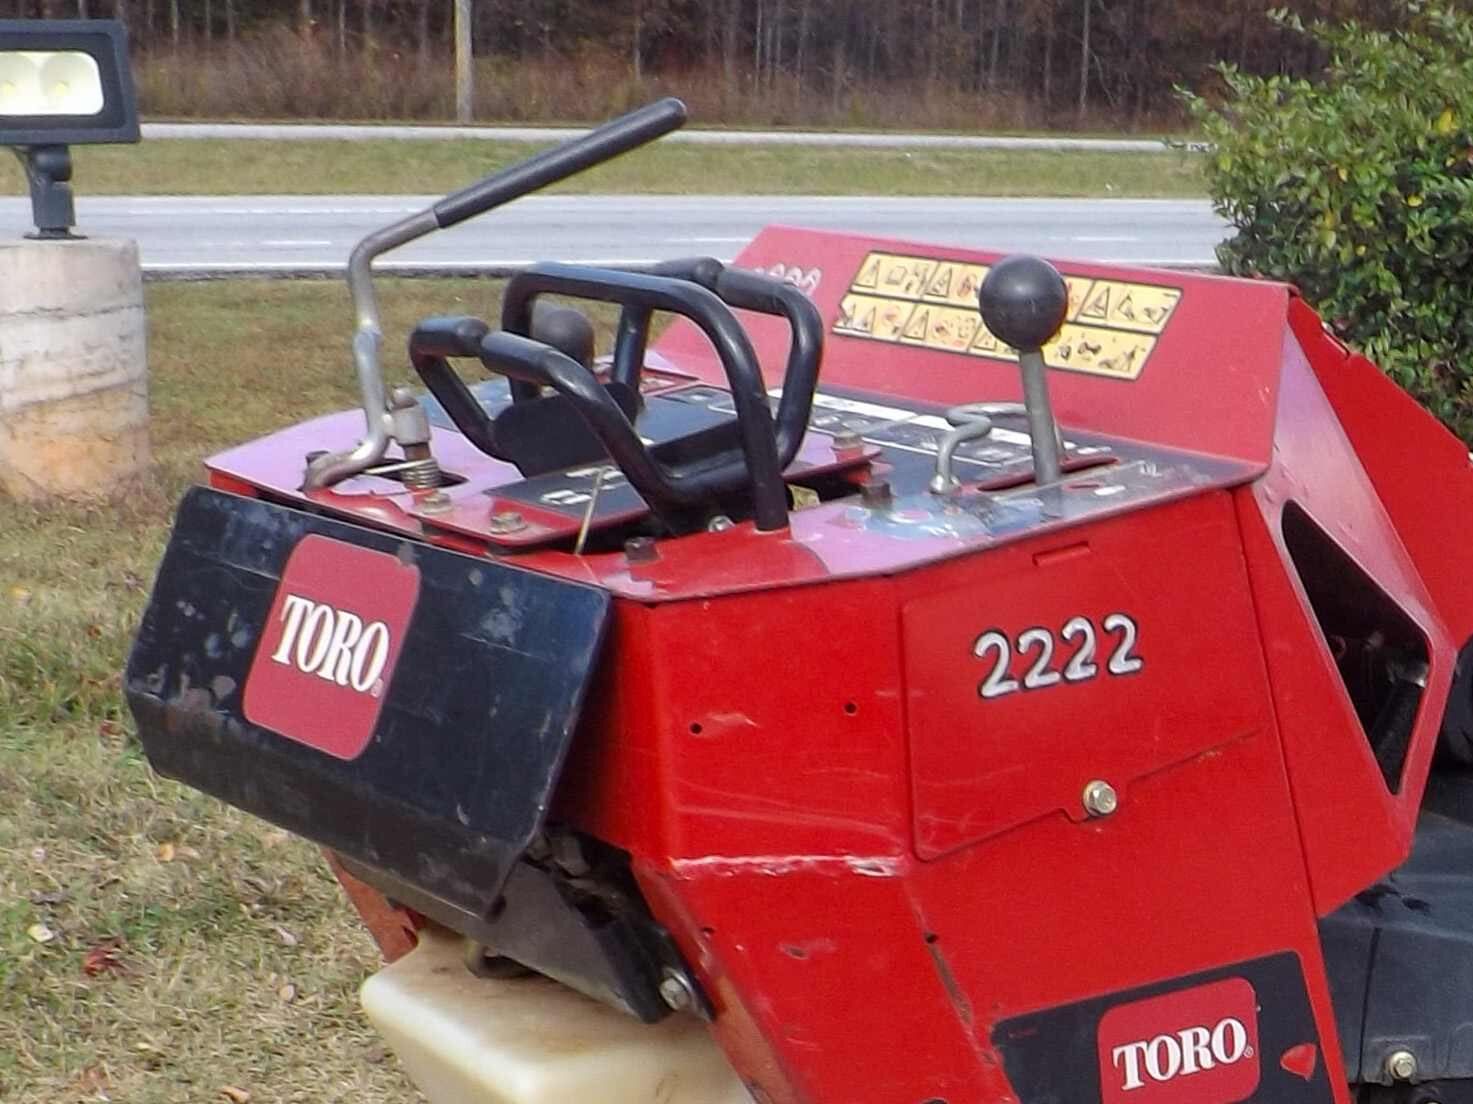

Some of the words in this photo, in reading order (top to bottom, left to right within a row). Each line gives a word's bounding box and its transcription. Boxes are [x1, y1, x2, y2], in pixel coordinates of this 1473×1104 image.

[271, 593, 390, 693] TORO
[972, 612, 1145, 699] 2222
[1112, 1017, 1247, 1091] TORO
